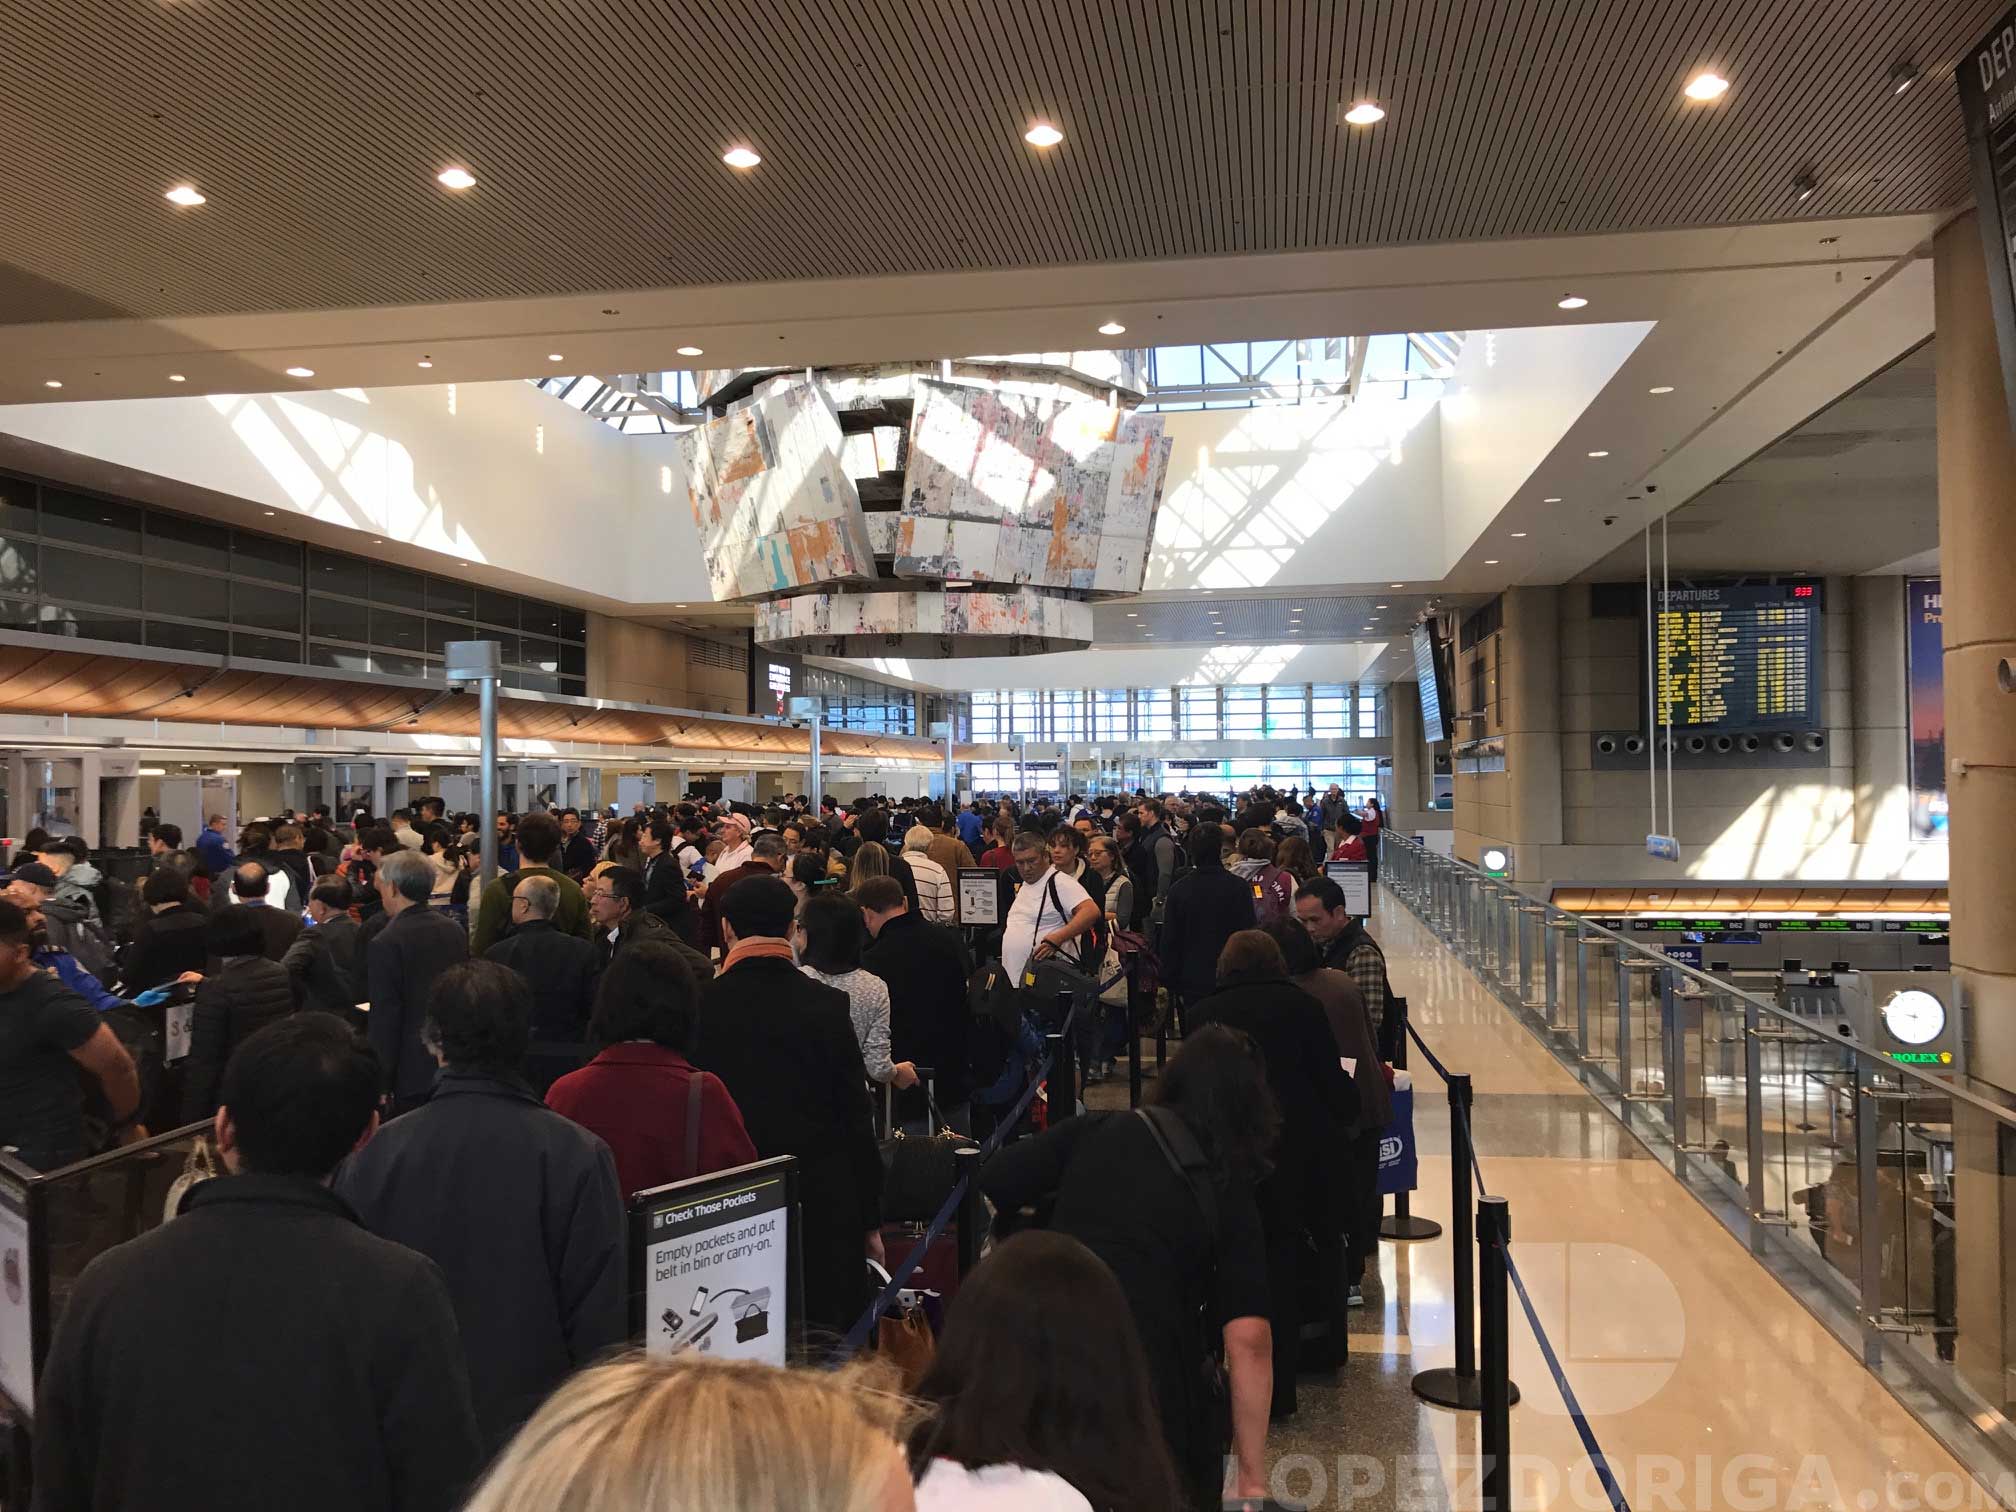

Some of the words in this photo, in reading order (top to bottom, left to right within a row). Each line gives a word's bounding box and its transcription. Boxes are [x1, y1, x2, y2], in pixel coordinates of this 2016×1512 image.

[1979, 24, 2016, 92] DEP
[1658, 589, 1720, 601] DEPARTURES
[1891, 1053, 1938, 1063] ROLEX
[665, 1208, 695, 1225] Check
[695, 1202, 721, 1217] Those
[723, 1192, 757, 1209] Pockets
[656, 1245, 692, 1264] Empty
[695, 1232, 735, 1255] pockets
[737, 1224, 756, 1240] and
[758, 1219, 776, 1236] put
[656, 1264, 678, 1281] belt
[680, 1261, 690, 1274] in
[693, 1256, 711, 1271] bin
[713, 1252, 725, 1265] or
[727, 1238, 773, 1261] carry-on.
